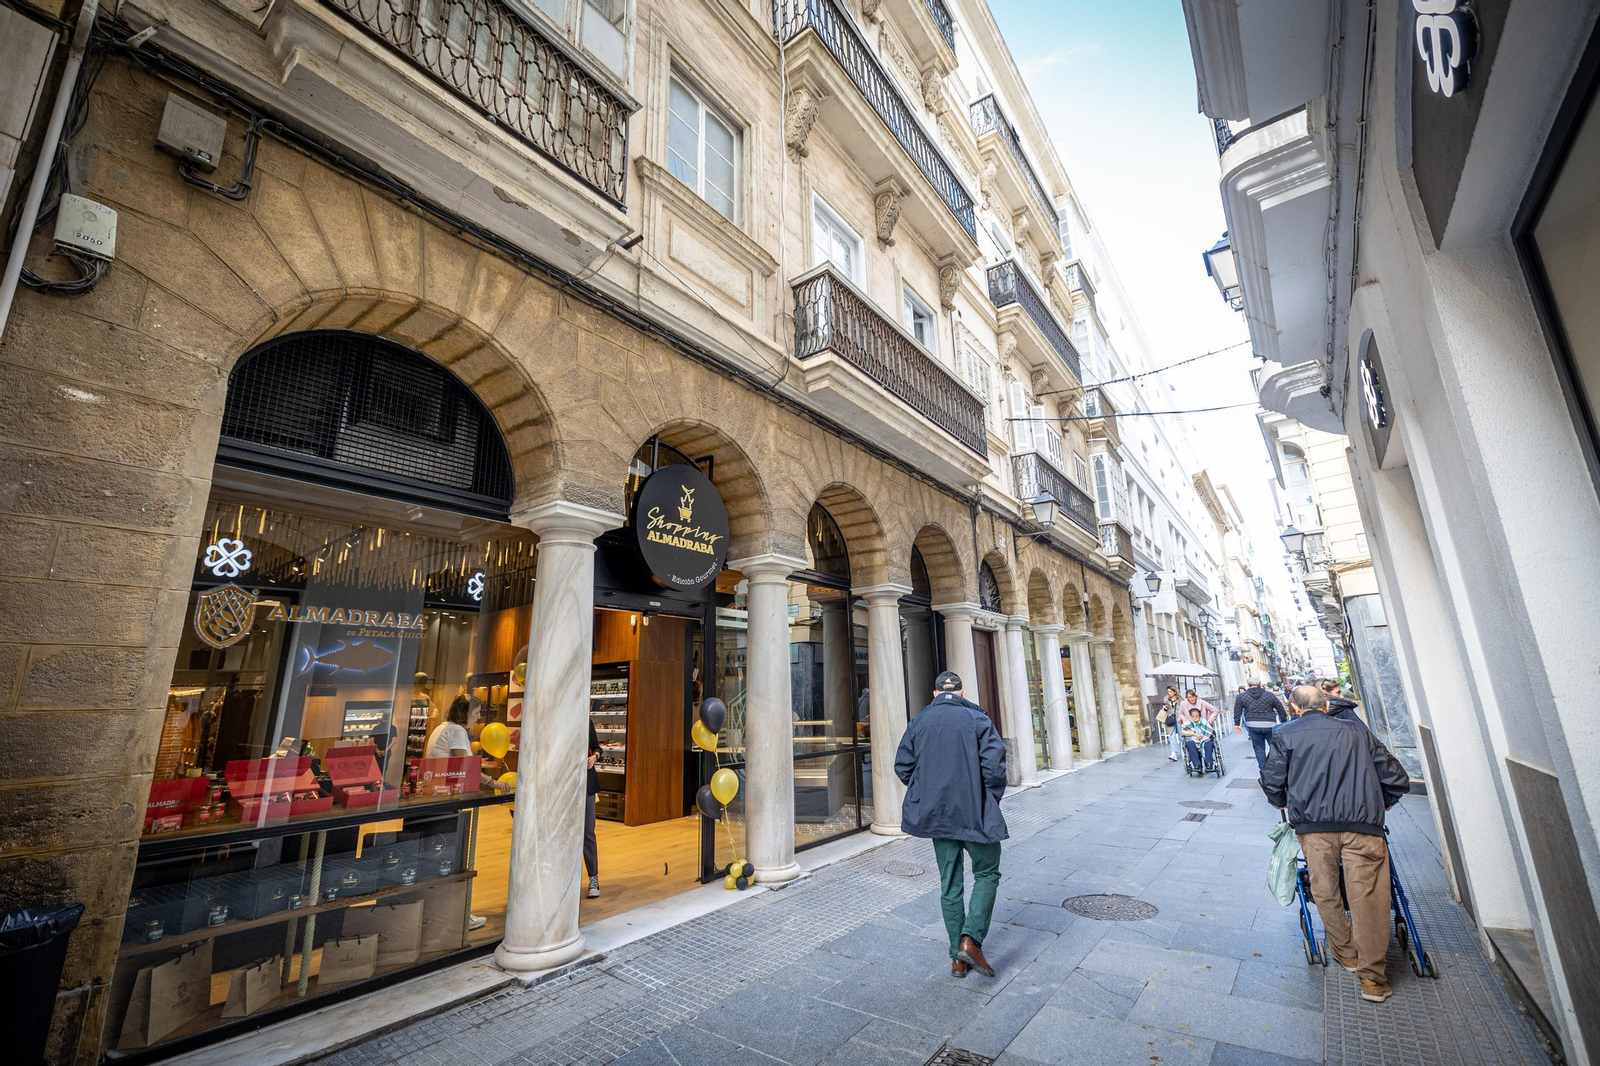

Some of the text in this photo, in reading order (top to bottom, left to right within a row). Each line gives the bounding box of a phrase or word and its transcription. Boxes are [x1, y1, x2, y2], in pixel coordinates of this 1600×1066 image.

[647, 506, 723, 544] Shopping
[646, 530, 715, 555] ALMADRABA
[671, 561, 718, 586] Edición Gourmet
[267, 604, 428, 629] ALMADRABA
